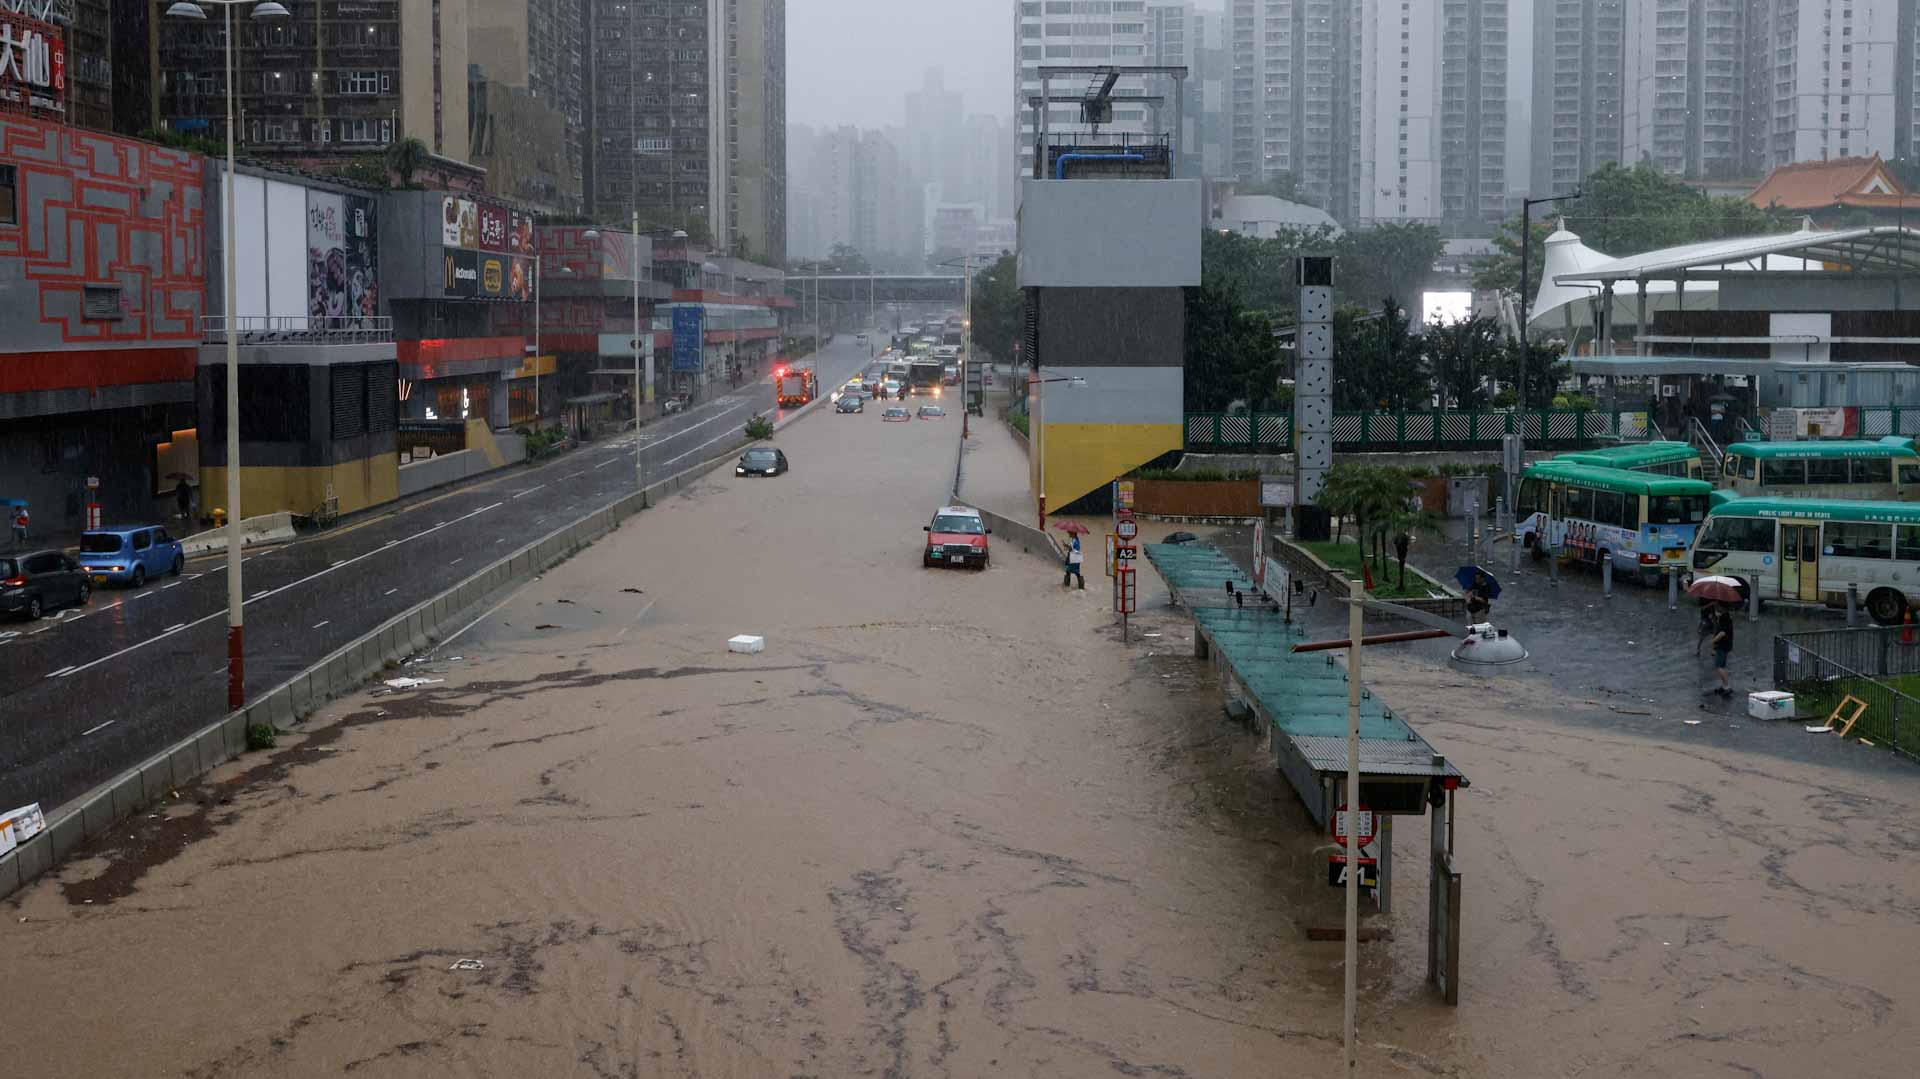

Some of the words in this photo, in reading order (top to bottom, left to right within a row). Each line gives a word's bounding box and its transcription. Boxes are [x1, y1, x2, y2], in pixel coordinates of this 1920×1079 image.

[54, 49, 65, 89] 中心
[1119, 549, 1133, 558] A2
[1337, 866, 1365, 885] A1
